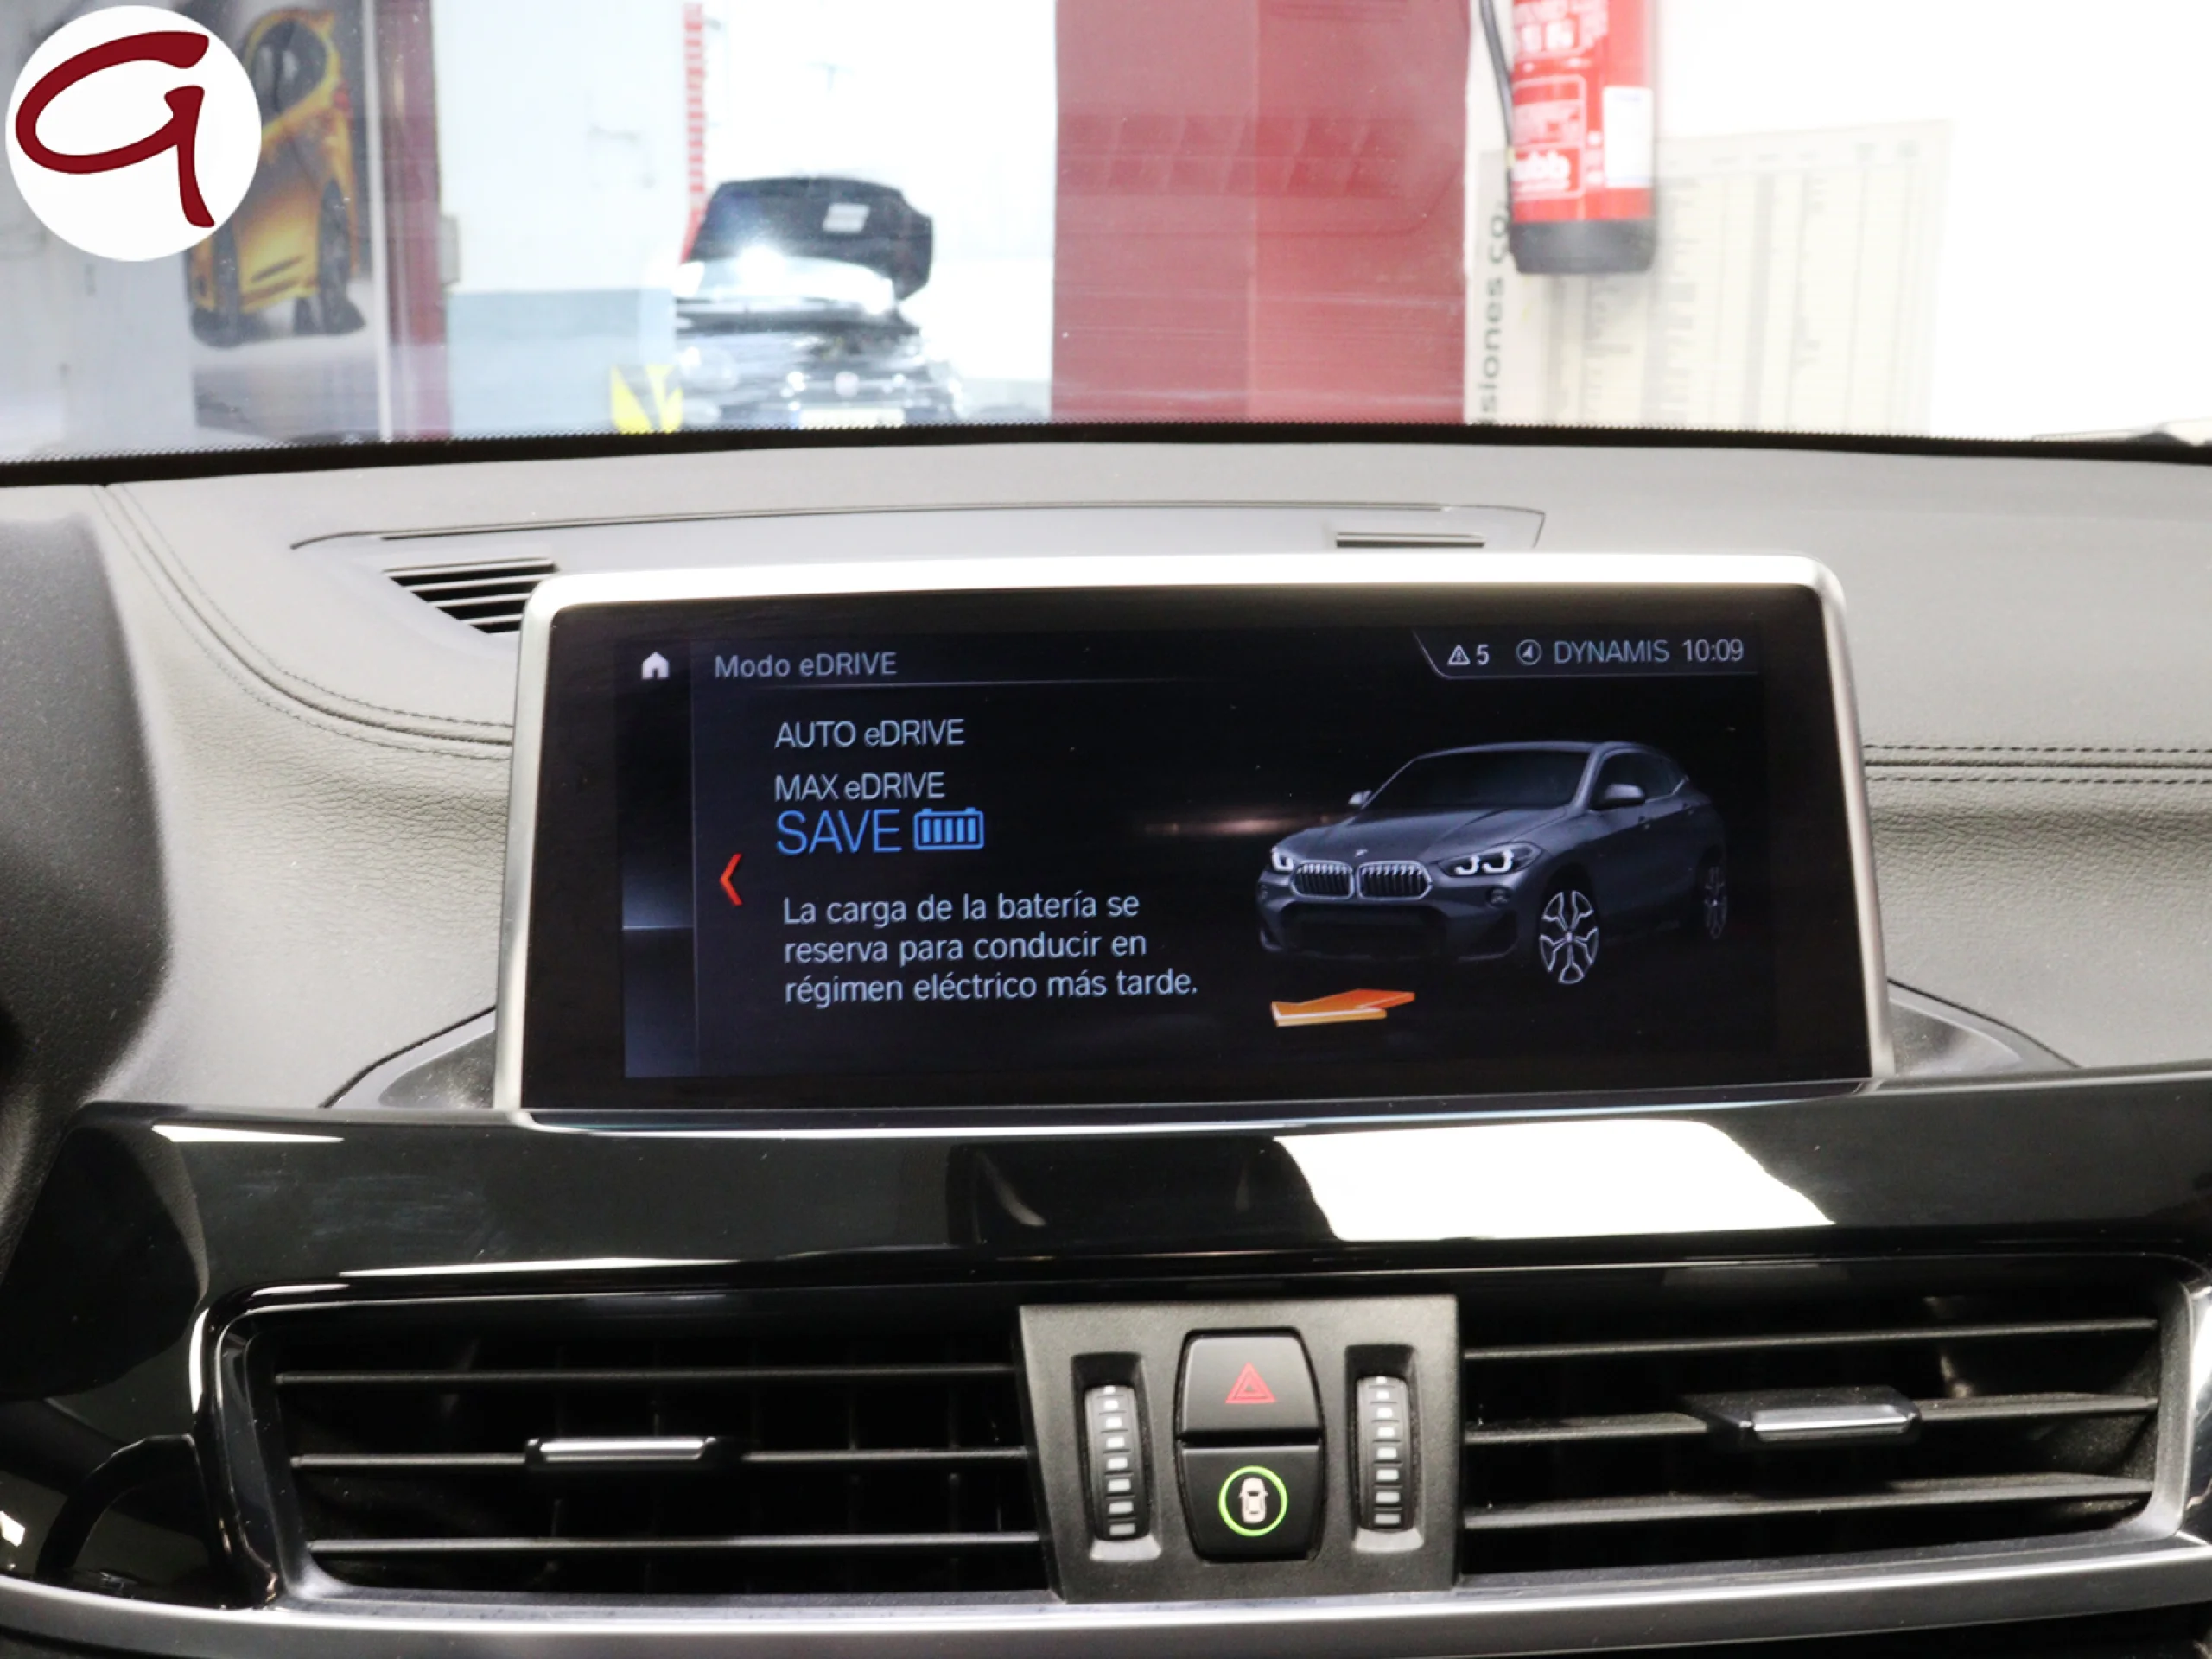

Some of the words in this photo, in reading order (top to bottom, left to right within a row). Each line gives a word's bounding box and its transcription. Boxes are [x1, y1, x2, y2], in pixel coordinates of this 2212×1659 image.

[1478, 277, 1505, 425] siones
[715, 654, 791, 678] Modo
[799, 652, 897, 677] eDRIVE
[1476, 644, 1490, 666] 5
[1554, 639, 1669, 664] DYNAMIS
[1682, 638, 1744, 662] 10:09
[775, 721, 856, 748] AUTO
[864, 718, 966, 747] eDRIVE
[775, 773, 840, 801] MAX
[844, 771, 945, 800] eDRIVE
[776, 809, 903, 855] SAVE
[783, 897, 817, 925] La
[826, 900, 906, 929] carga
[916, 893, 954, 922] de
[963, 893, 987, 920] la
[997, 889, 1097, 920] batería
[1107, 895, 1140, 918] se
[785, 940, 888, 964] reserva
[899, 939, 963, 967] para
[973, 930, 1103, 960] conducir
[1110, 935, 1147, 957] en
[785, 973, 904, 1010] régimen
[913, 971, 1038, 1001] eléctrico
[1047, 969, 1108, 997] más
[1116, 967, 1198, 996] tarde.
